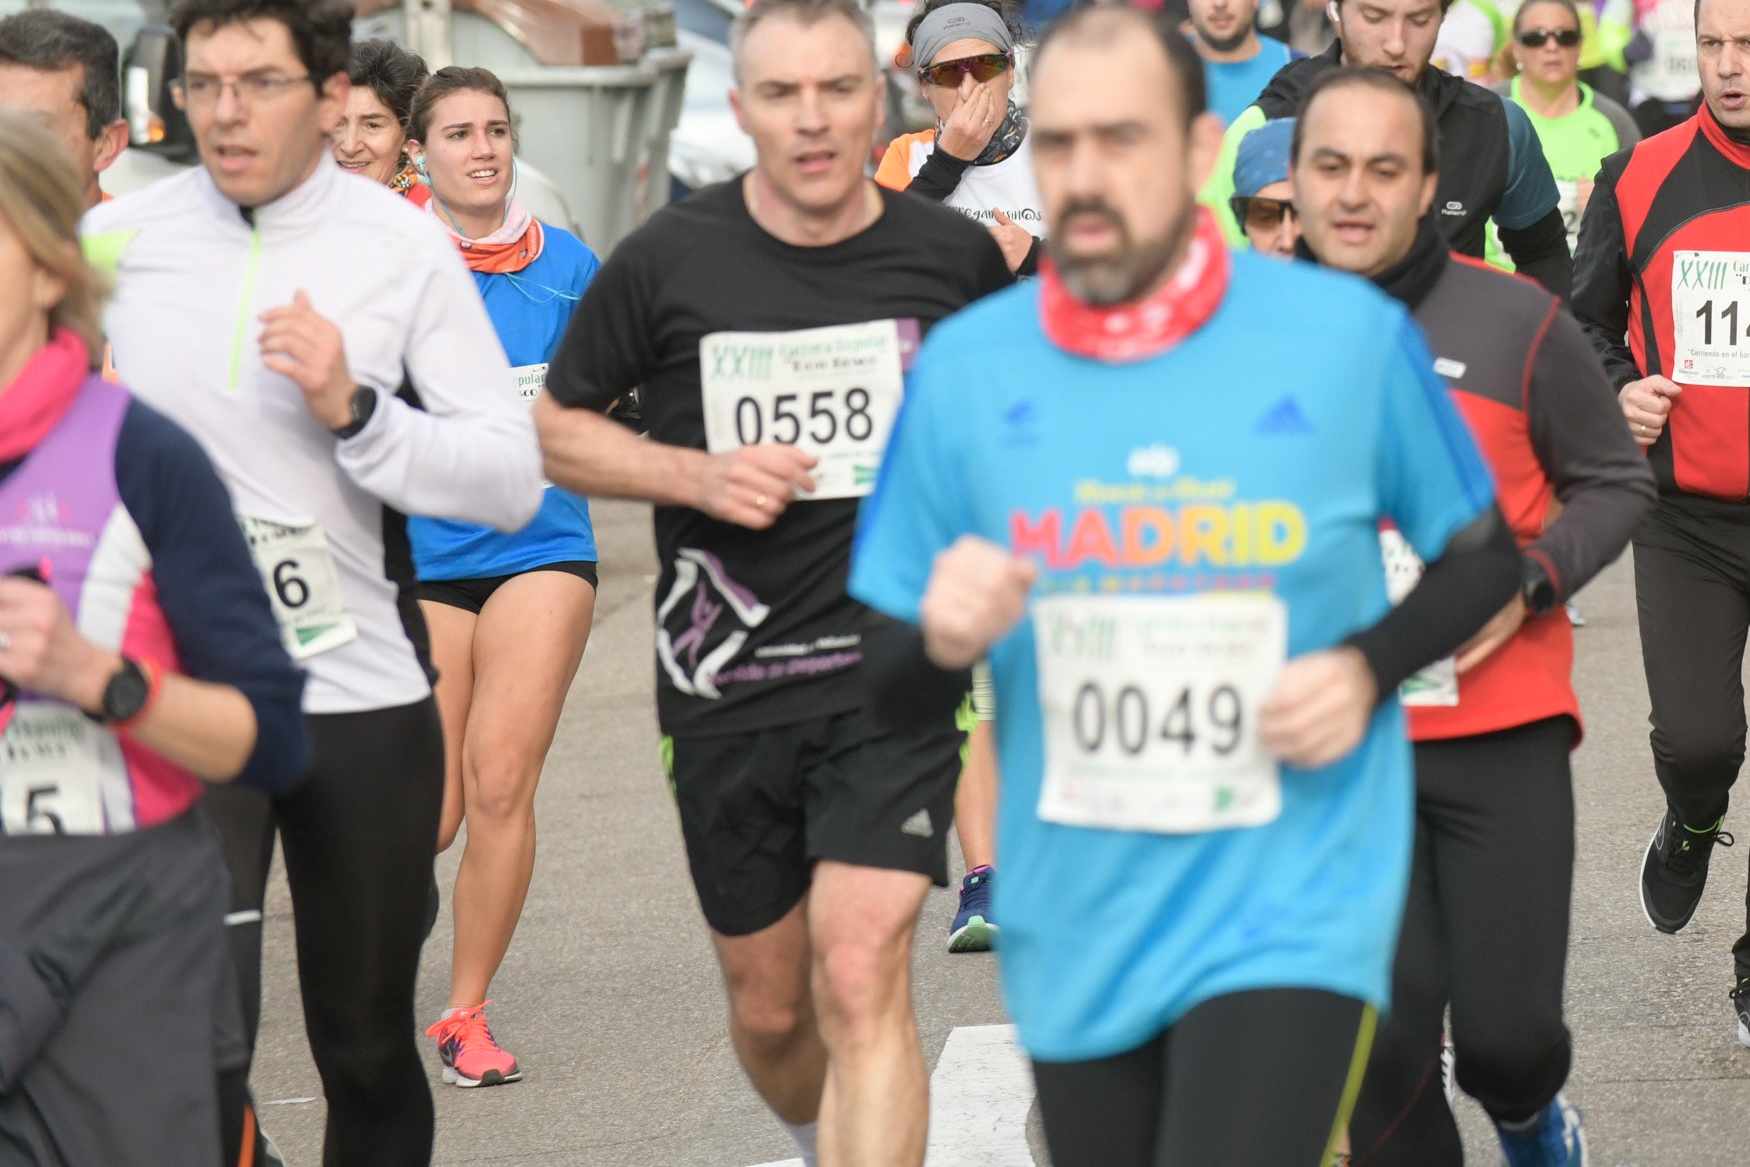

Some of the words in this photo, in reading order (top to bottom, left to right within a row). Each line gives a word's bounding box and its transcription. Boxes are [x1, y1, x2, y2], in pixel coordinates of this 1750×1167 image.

[1677, 259, 1728, 290] XXIII
[736, 387, 873, 447] 0558
[1010, 501, 1307, 570] MADRID
[273, 560, 309, 609] 6
[1073, 682, 1244, 756] 0049
